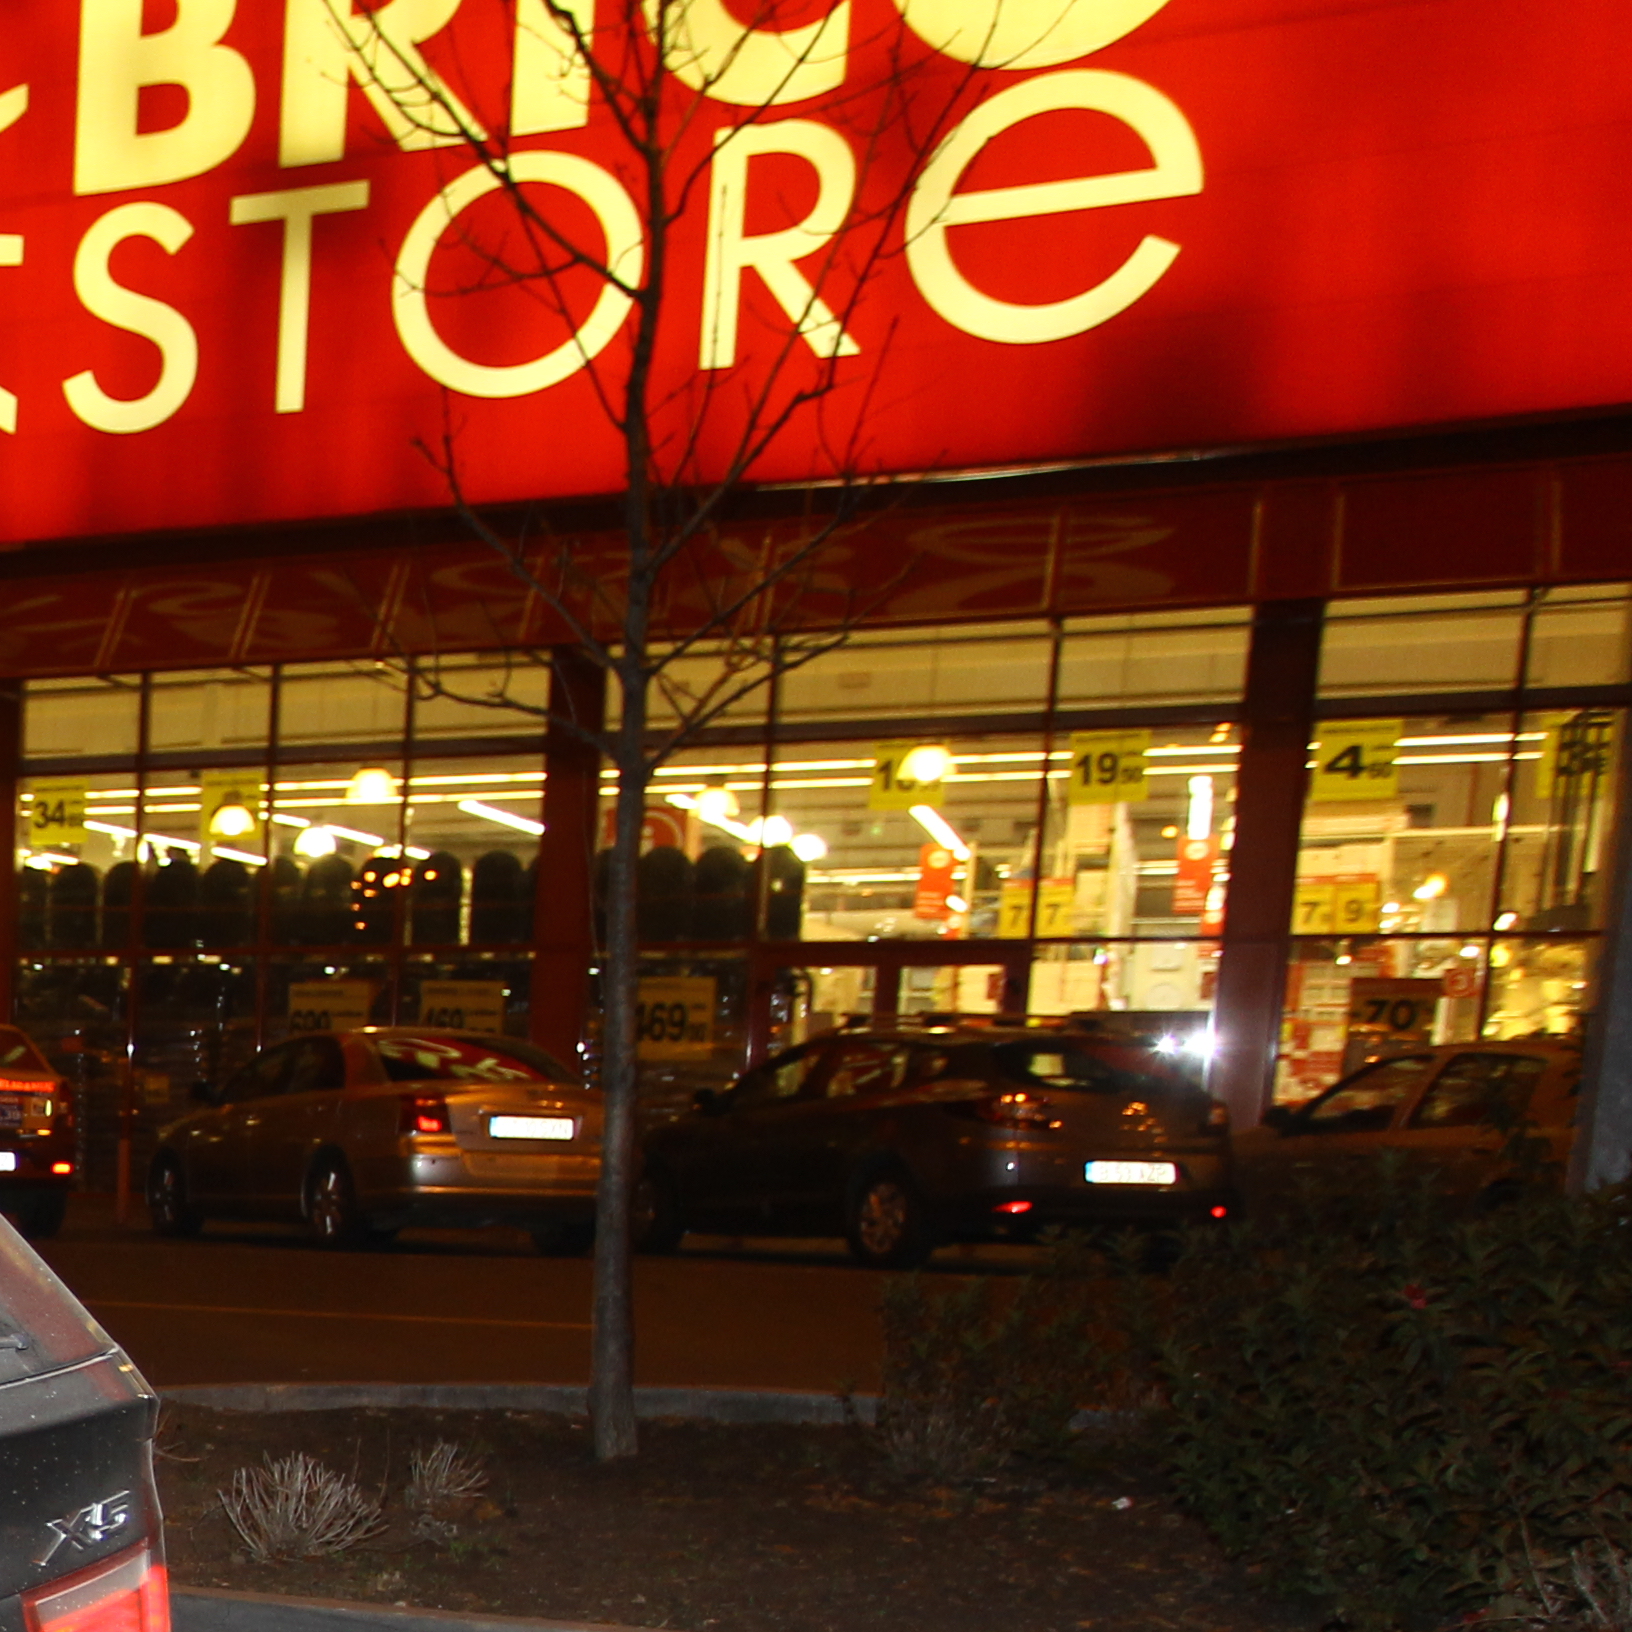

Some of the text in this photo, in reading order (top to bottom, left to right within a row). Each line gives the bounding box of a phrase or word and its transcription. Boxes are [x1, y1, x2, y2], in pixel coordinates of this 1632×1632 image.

[1075, 753, 1118, 789] 19
[1323, 745, 1364, 781] 4
[33, 800, 66, 830] 34
[38, 1489, 130, 1567] X5
